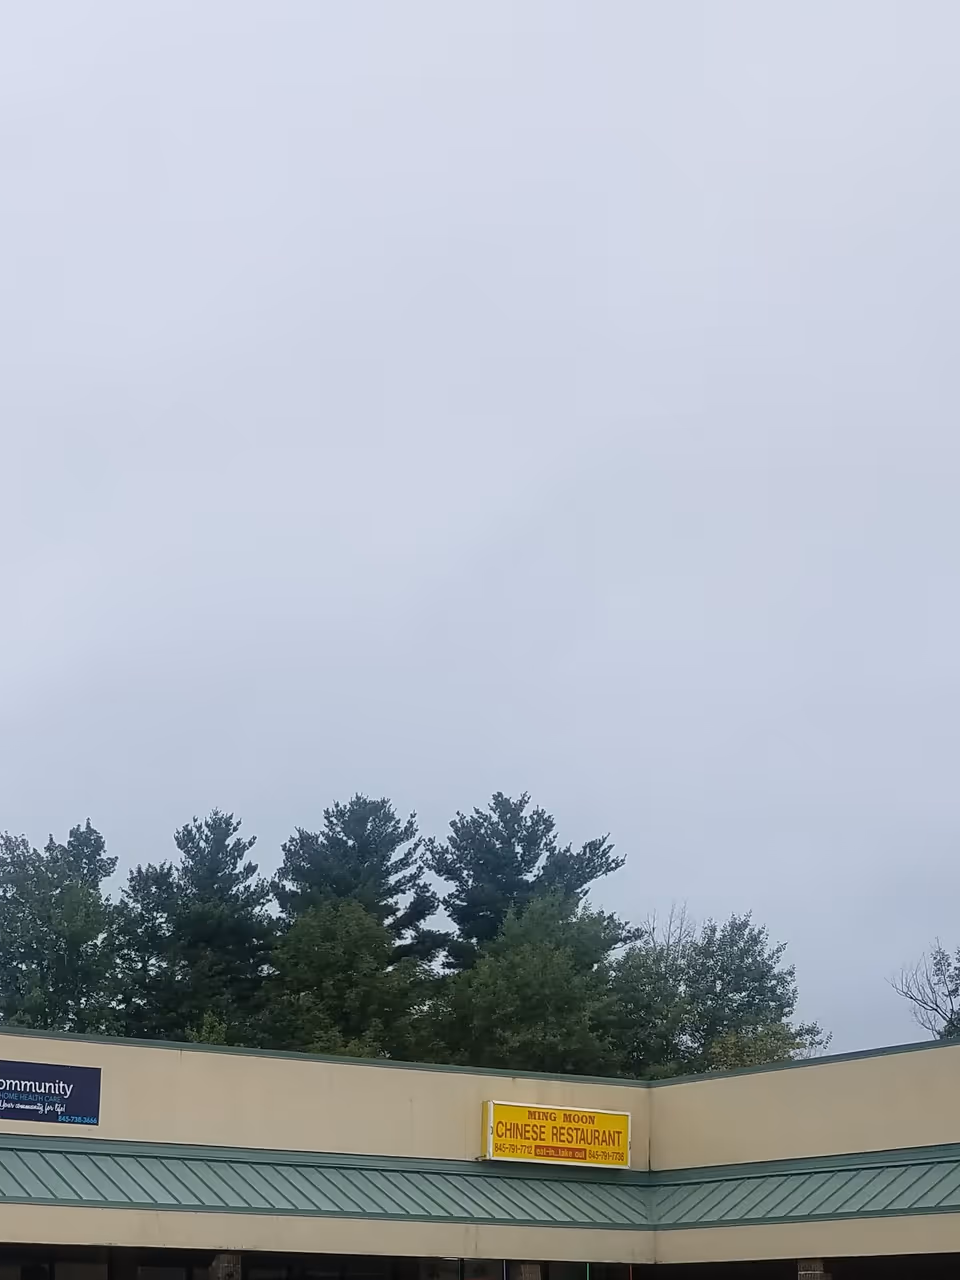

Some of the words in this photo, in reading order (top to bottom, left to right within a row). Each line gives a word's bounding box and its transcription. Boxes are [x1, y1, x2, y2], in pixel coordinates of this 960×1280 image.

[19, 1093, 44, 1102] HEALTH
[44, 1095, 61, 1103] CARE
[527, 1110, 557, 1121] MING
[563, 1113, 596, 1125] MOON
[496, 1121, 546, 1141] CHINESE
[551, 1126, 623, 1147] RESTAURANT
